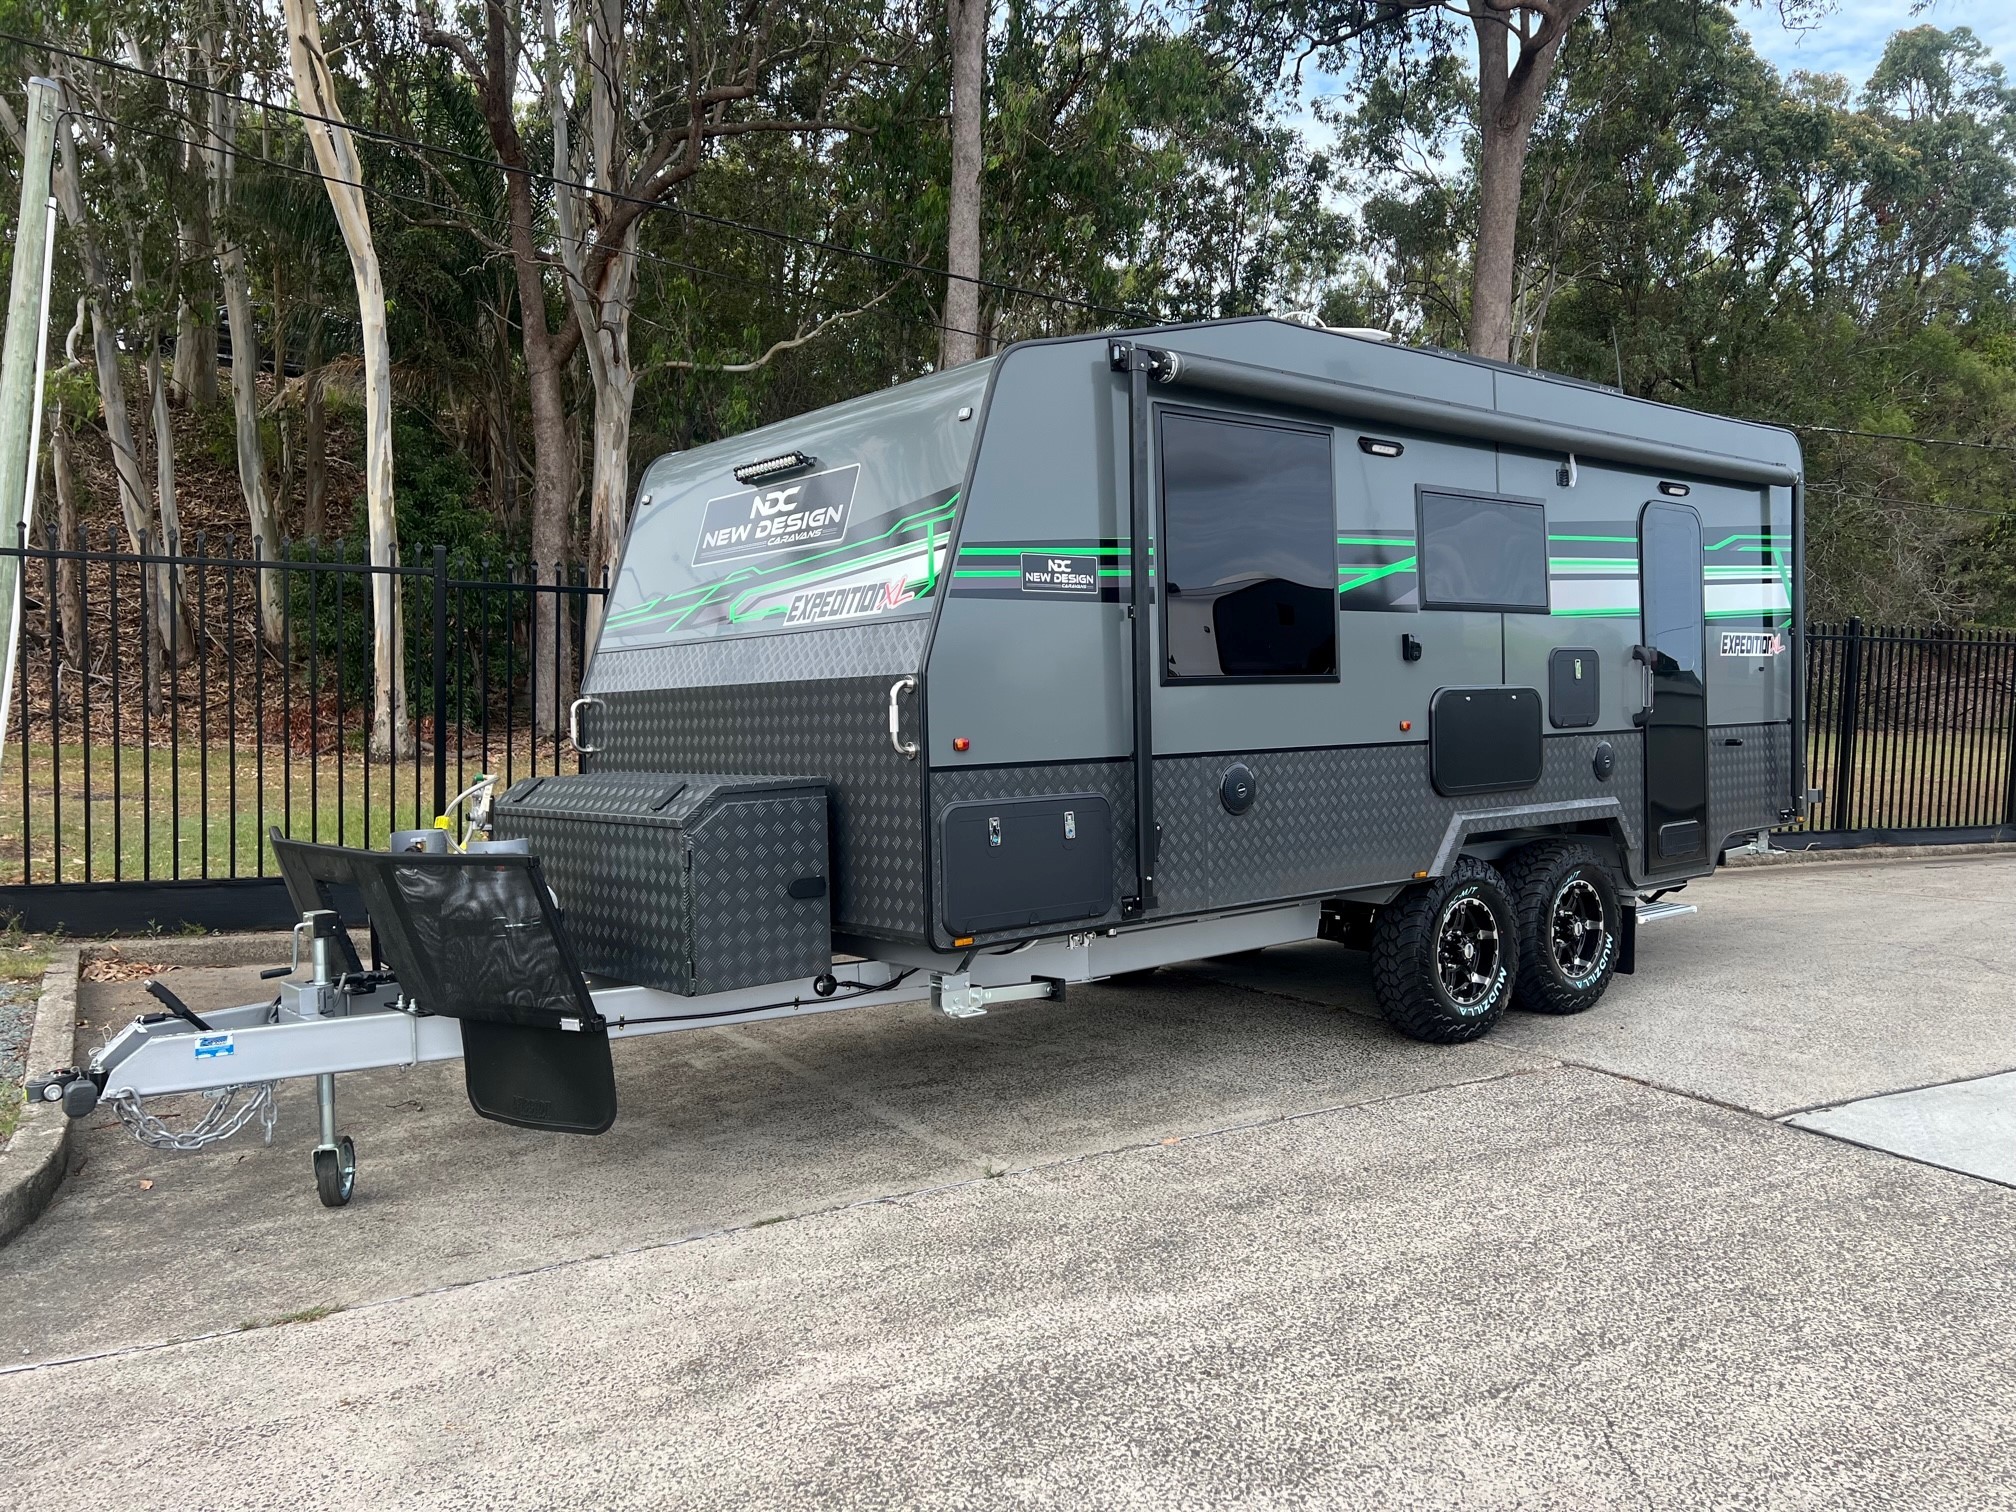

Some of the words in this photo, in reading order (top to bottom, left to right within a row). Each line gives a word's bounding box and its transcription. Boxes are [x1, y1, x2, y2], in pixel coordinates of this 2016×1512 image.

[750, 486, 802, 519] NDC
[702, 523, 752, 549] NEW
[754, 504, 844, 539] DESIGN
[767, 528, 823, 546] CARAVANS
[1025, 572, 1051, 583] NEW
[1054, 573, 1094, 584] DESIGN
[1047, 559, 1072, 573] NDC
[1576, 932, 1613, 989] MUDZILLA
[1459, 966, 1507, 1017] MUDZILLA
